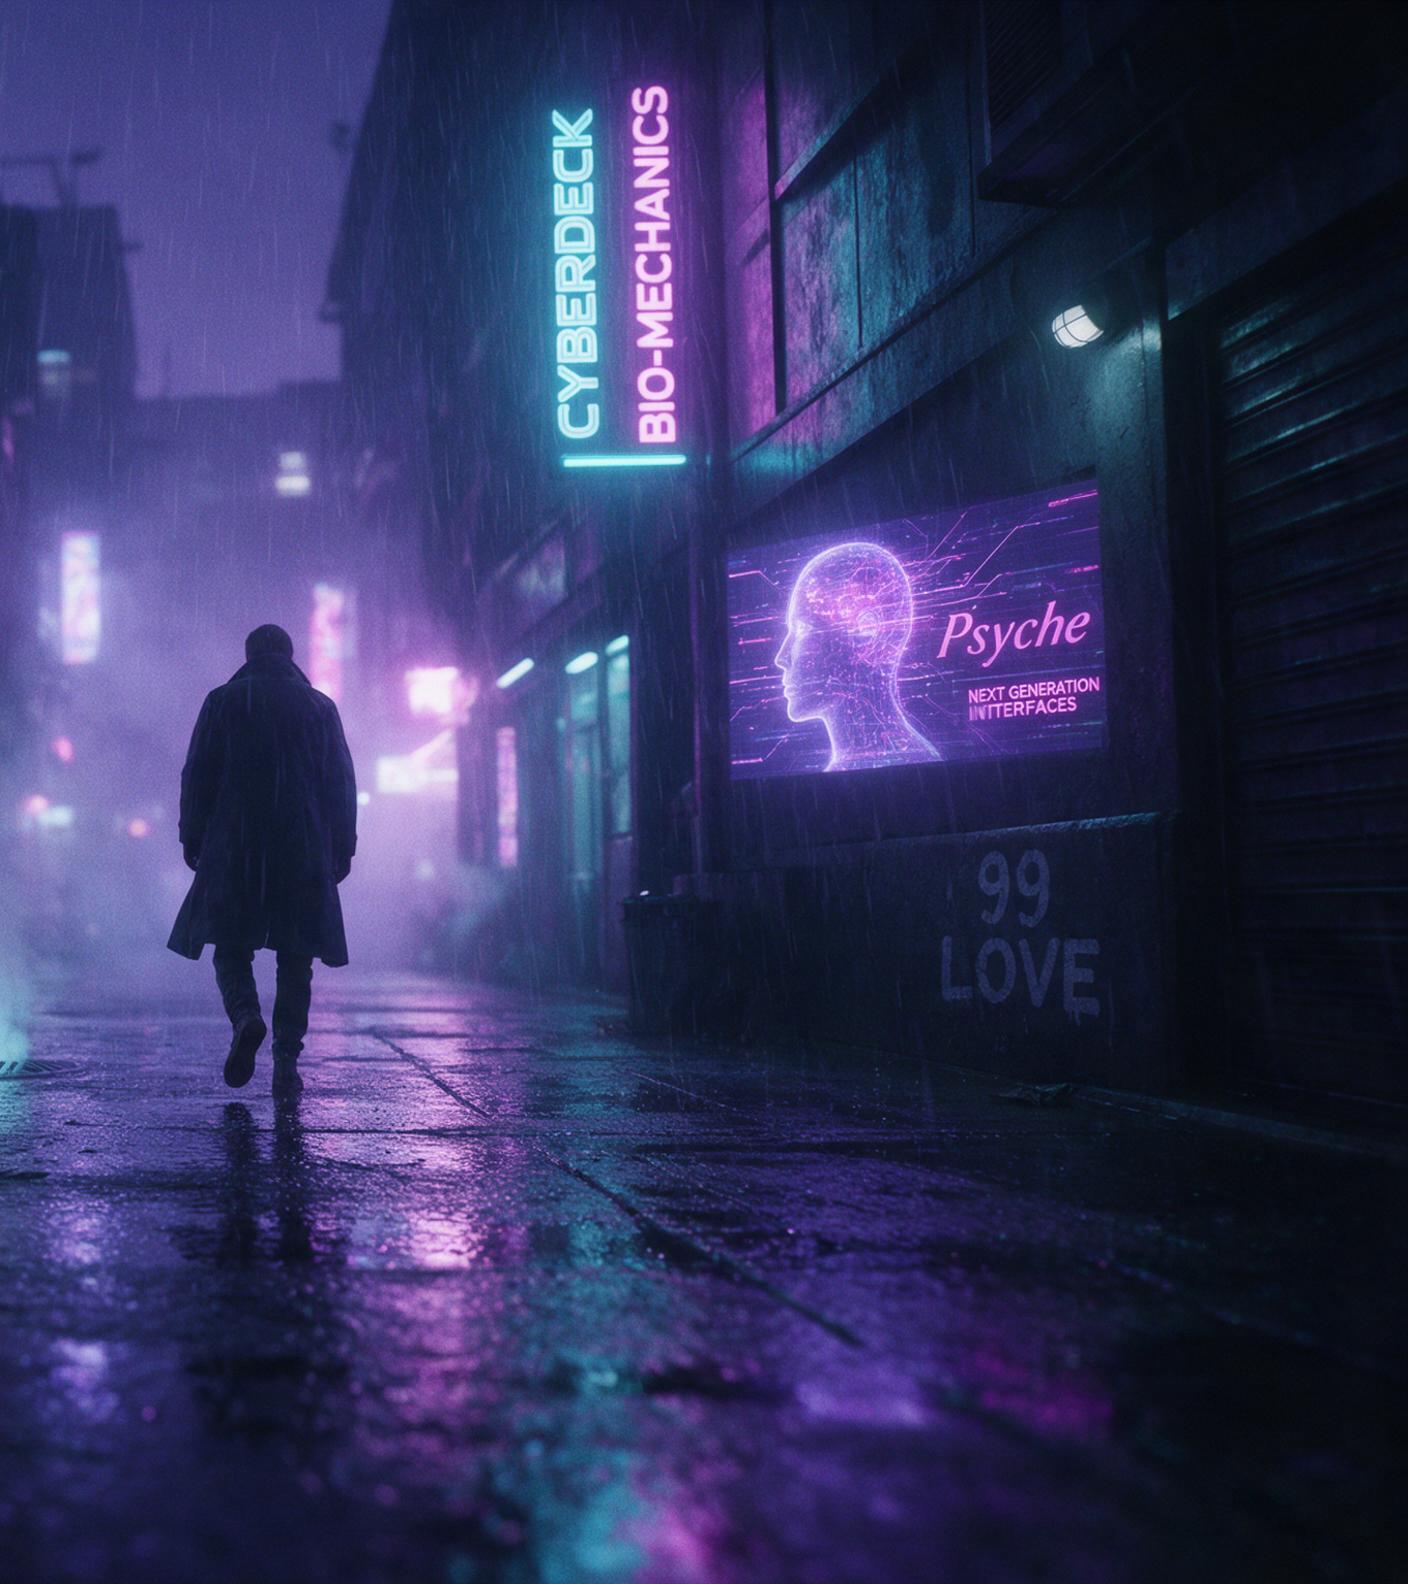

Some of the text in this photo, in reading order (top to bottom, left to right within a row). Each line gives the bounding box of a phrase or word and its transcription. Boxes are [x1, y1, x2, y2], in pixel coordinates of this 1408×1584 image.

[551, 108, 600, 440] CYBERDECK
[631, 85, 677, 444] BIO-MECHANICS
[936, 600, 1092, 668] Psyche
[968, 676, 1100, 704] NEXT GENERATION
[978, 849, 1051, 929] 99
[942, 935, 1101, 1020] LOVE
